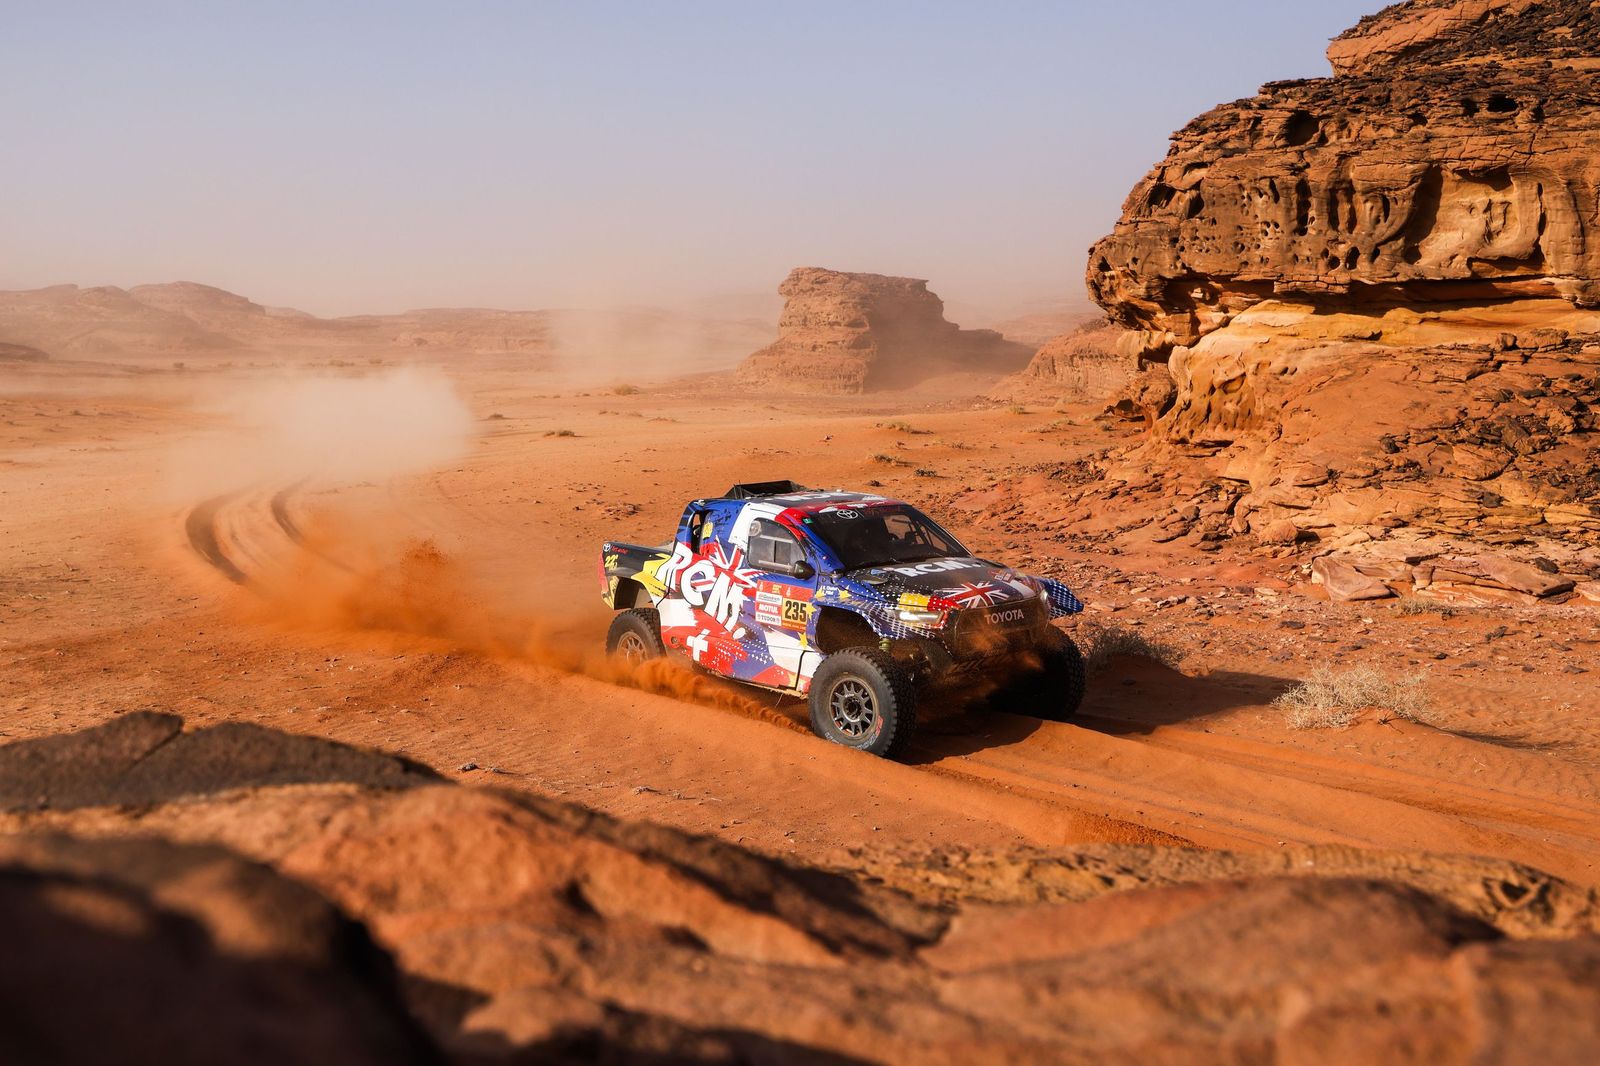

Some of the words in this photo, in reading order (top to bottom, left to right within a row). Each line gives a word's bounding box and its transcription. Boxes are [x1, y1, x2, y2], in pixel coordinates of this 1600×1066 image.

[759, 603, 778, 614] MOTUL
[785, 600, 807, 622] 235
[984, 608, 1025, 625] TOYOTA
